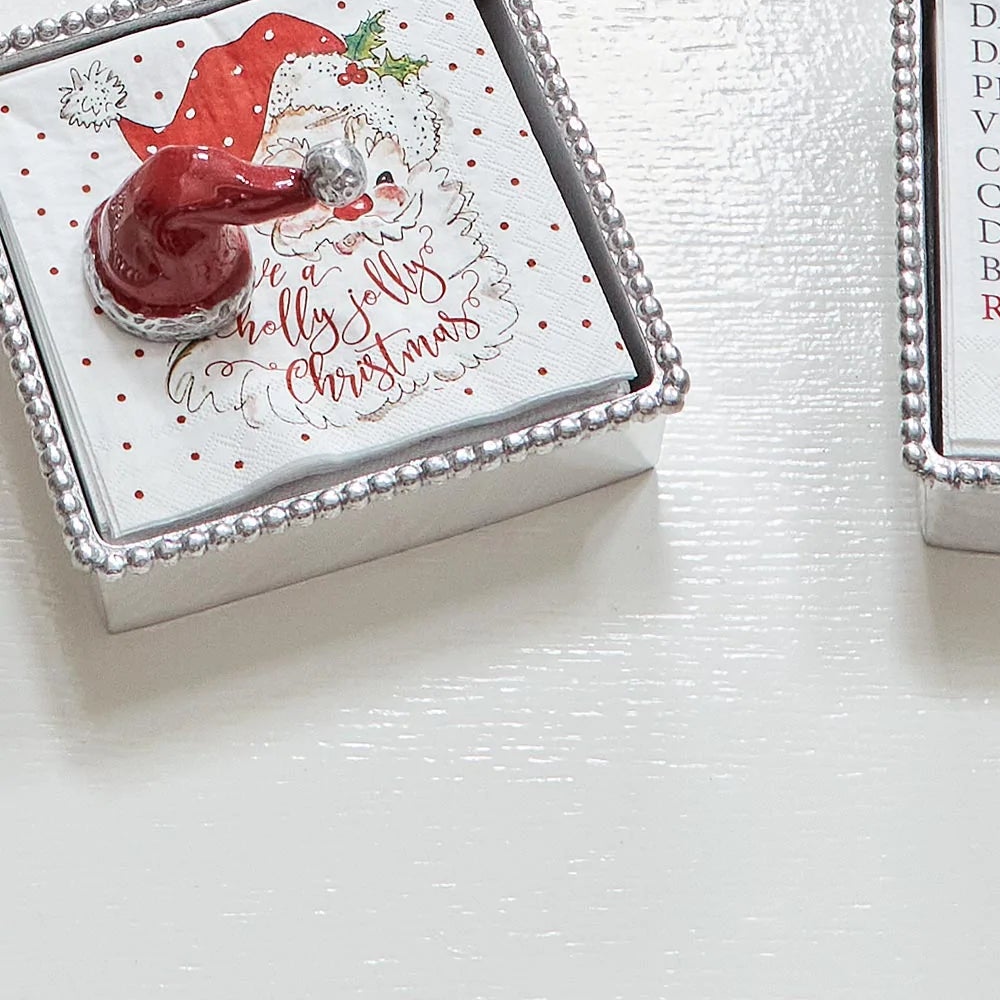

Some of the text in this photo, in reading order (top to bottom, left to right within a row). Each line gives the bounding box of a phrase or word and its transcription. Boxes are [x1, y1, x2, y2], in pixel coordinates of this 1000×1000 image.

[216, 224, 447, 356] holly jolly
[285, 269, 482, 404] Christmas
[300, 263, 343, 288] a
